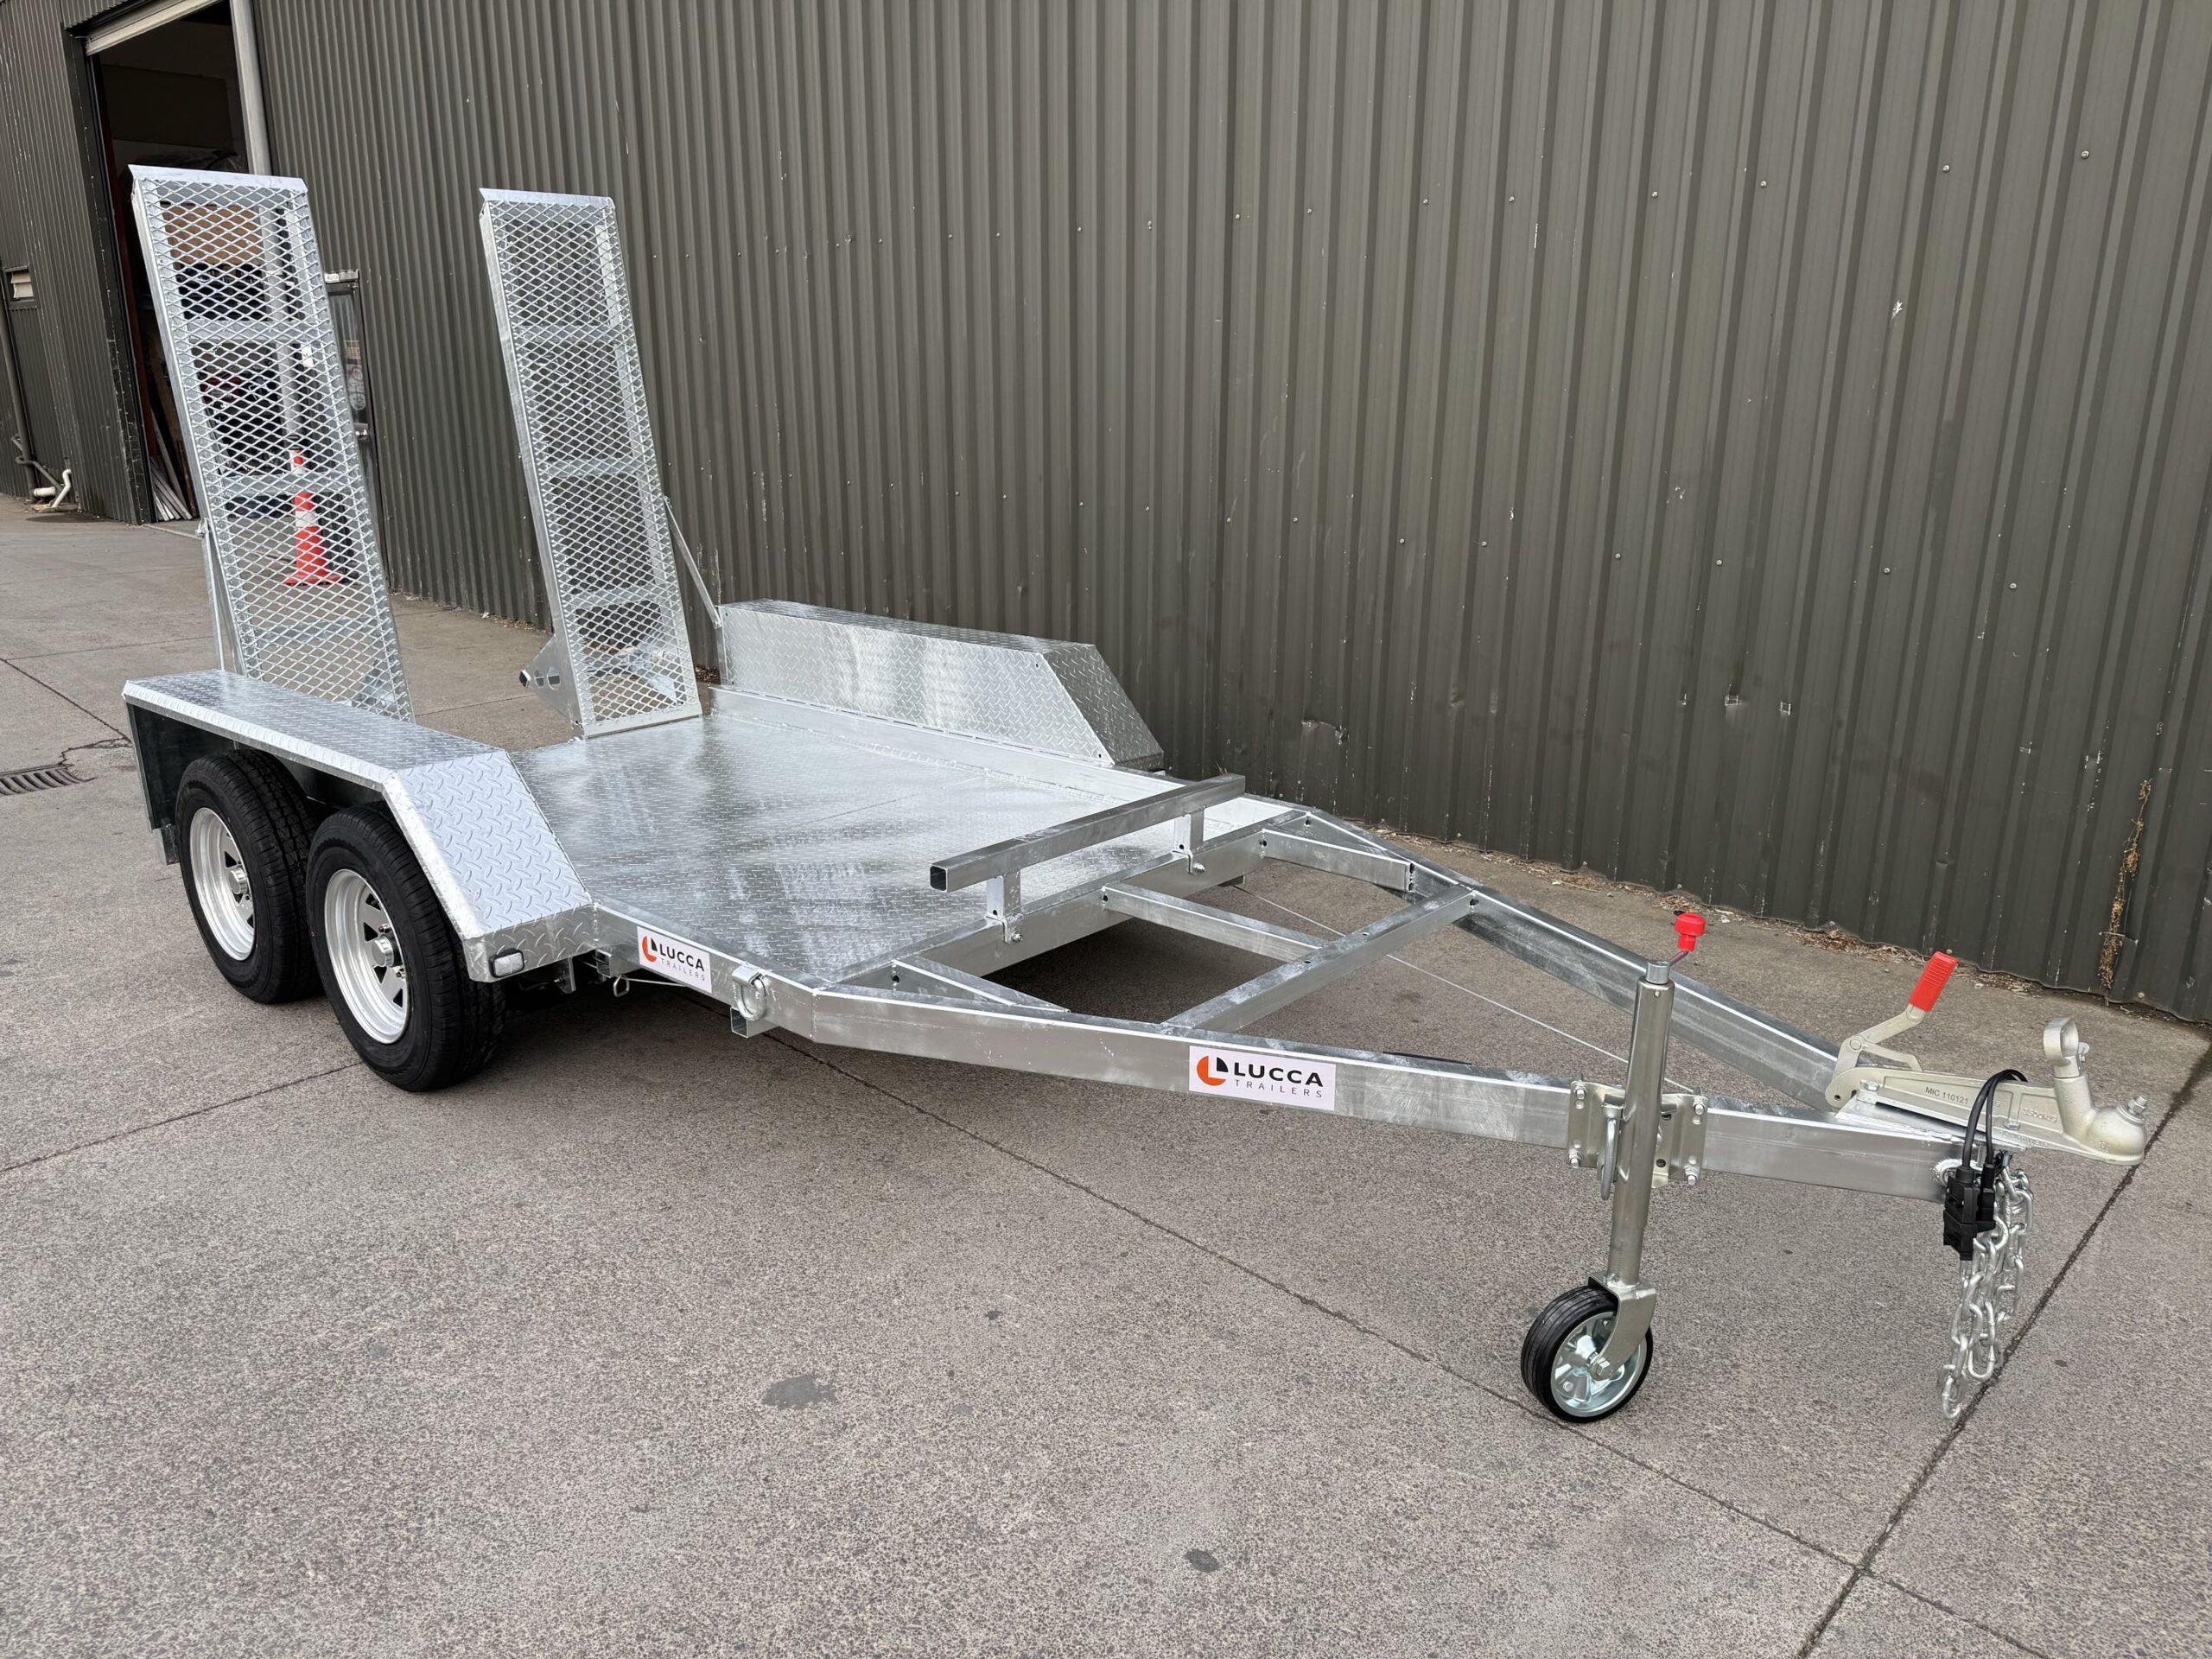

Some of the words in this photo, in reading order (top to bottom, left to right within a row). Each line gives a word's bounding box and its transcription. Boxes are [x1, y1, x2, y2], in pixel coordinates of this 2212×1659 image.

[659, 944, 705, 972] LUCCA
[660, 957, 706, 982] TRAILERS
[1234, 1062, 1324, 1088] LUCCA
[1235, 1079, 1322, 1098] TRAILERS
[1942, 1091, 1968, 1105] 110121
